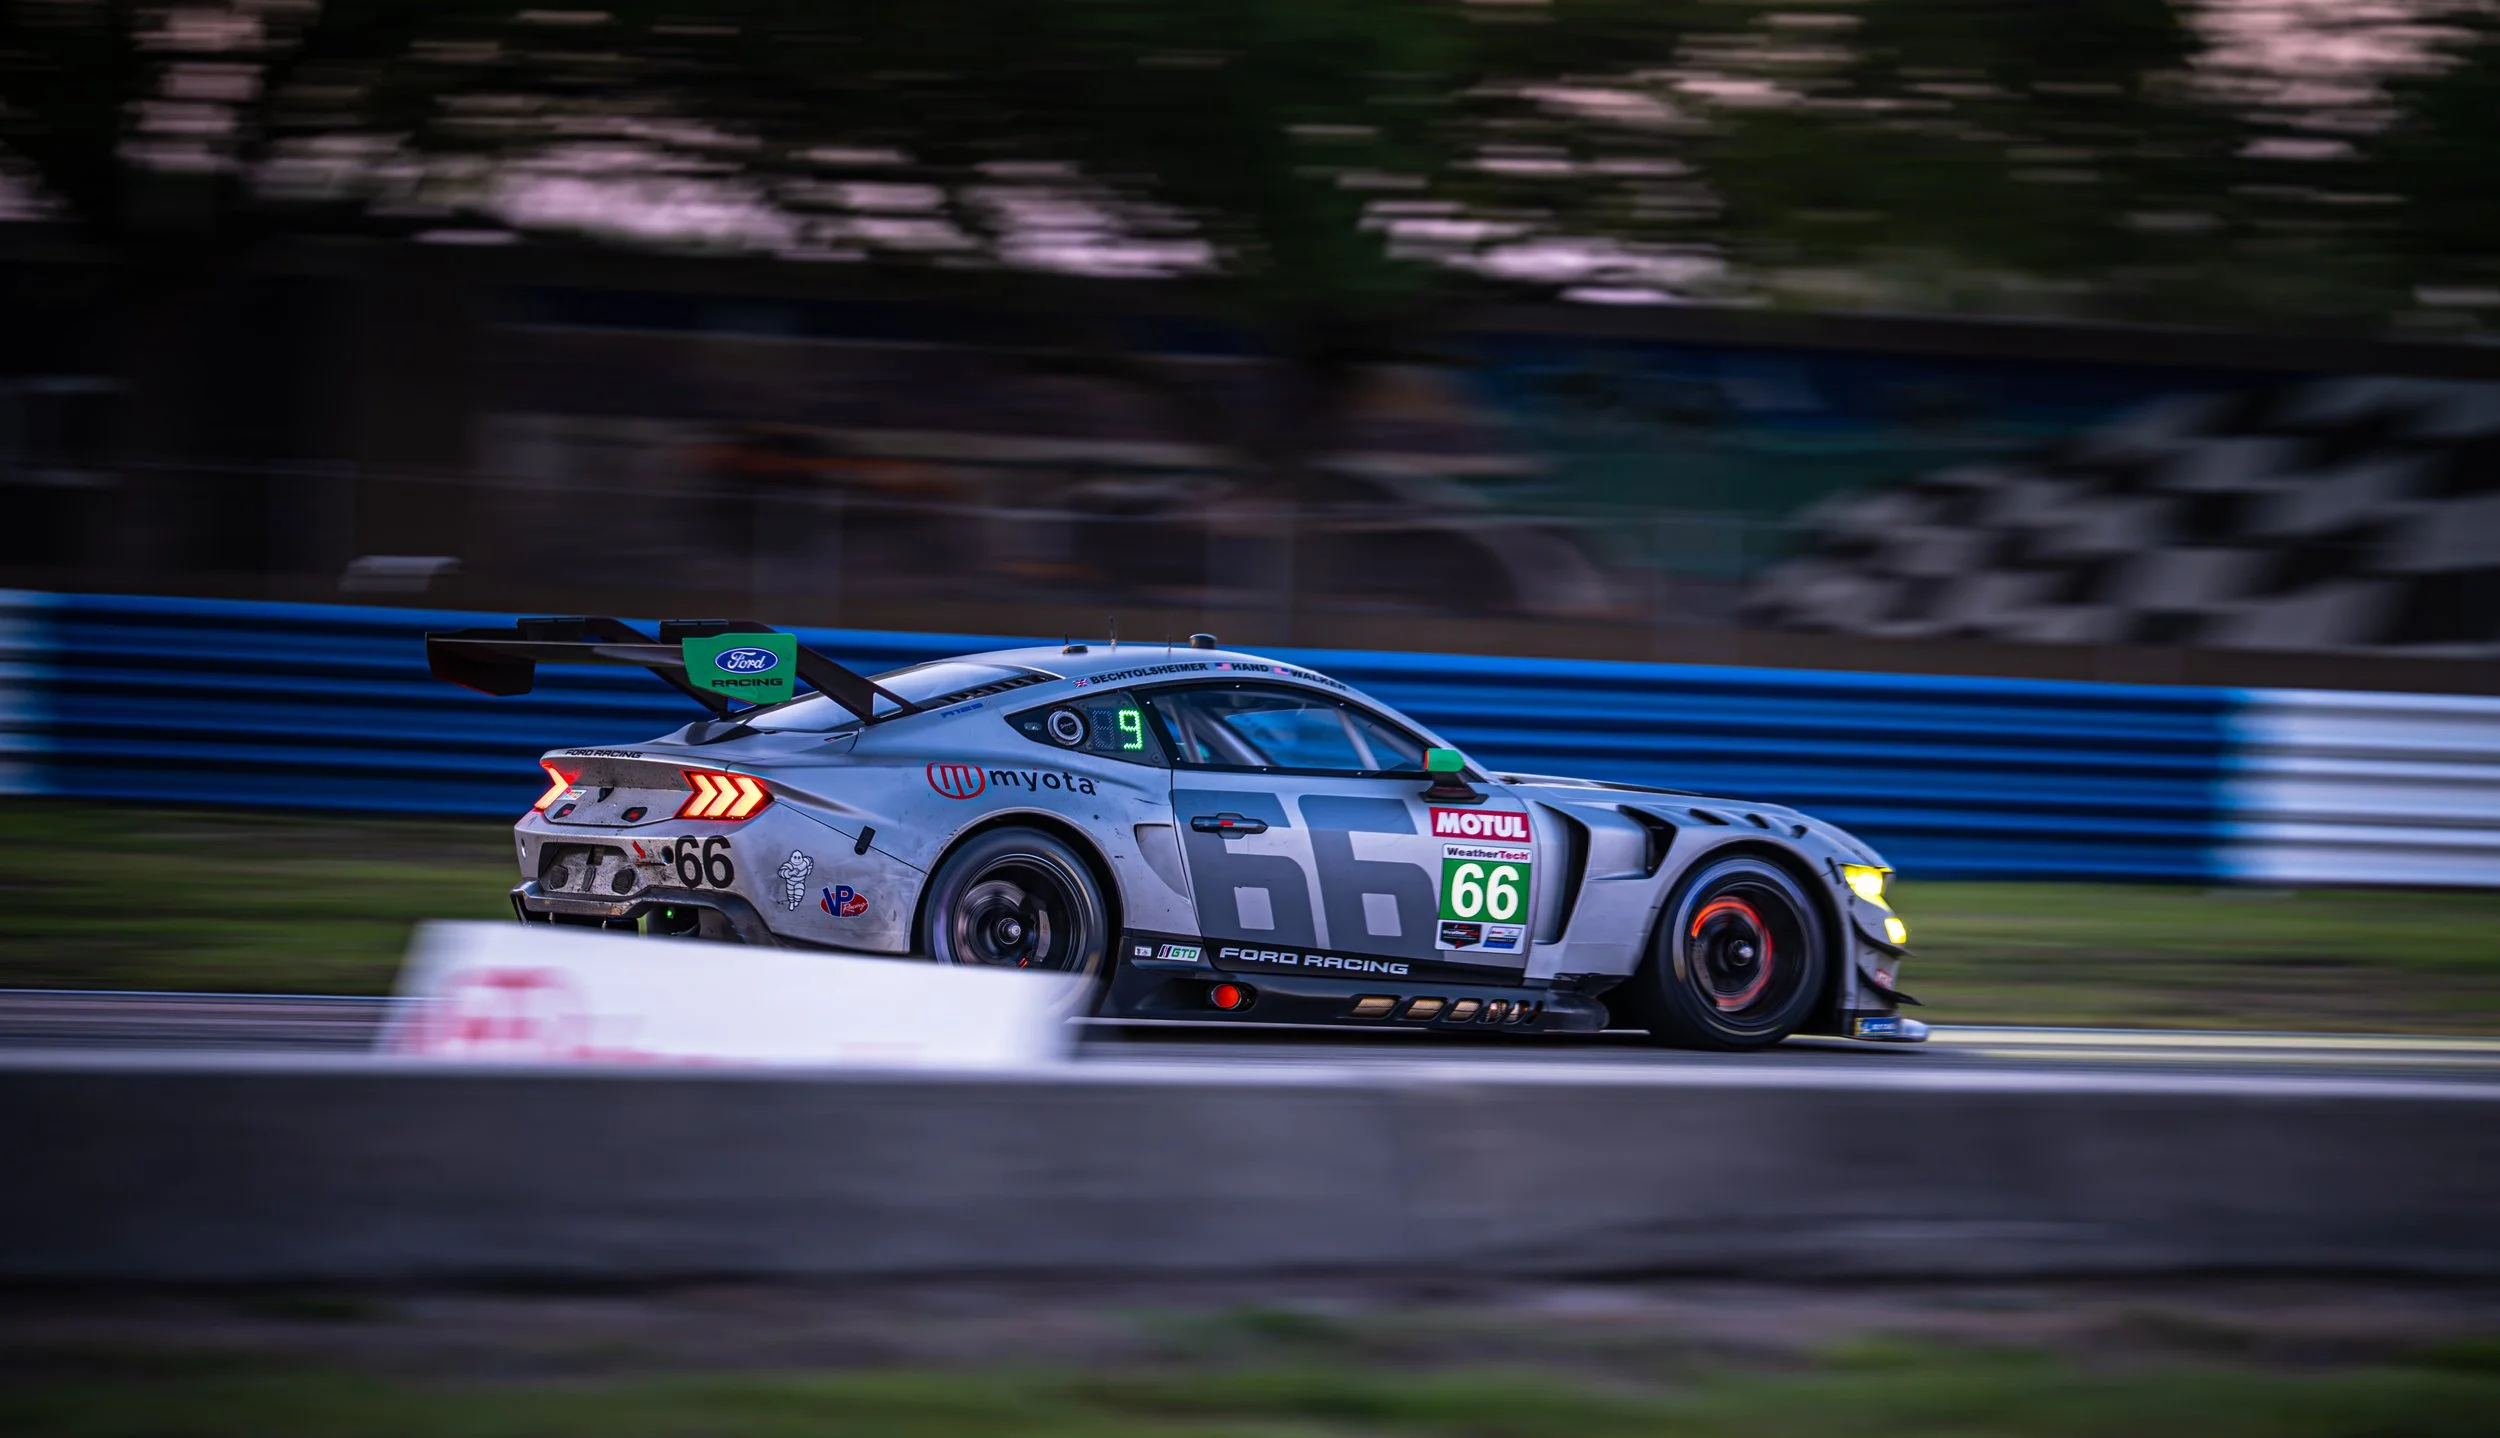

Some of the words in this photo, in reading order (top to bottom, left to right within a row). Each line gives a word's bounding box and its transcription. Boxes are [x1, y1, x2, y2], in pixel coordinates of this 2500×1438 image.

[727, 650, 766, 670] Ford
[712, 678, 784, 688] RACING
[1090, 663, 1208, 685] BECHTOLSHEIMER
[1233, 662, 1269, 673] HAND
[1290, 669, 1348, 692] WALKER
[1118, 709, 1144, 750] 9
[594, 750, 643, 759] RACING
[989, 769, 1097, 797] myota
[1436, 811, 1527, 838] MOTUL
[675, 834, 735, 890] 66
[1447, 847, 1528, 860] WeatherTech
[1168, 788, 1443, 960] 66
[822, 885, 855, 917] VP
[1451, 863, 1520, 920] 66
[1171, 947, 1198, 960] GTD
[1219, 947, 1298, 965] FORD
[1303, 954, 1409, 976] RACING
